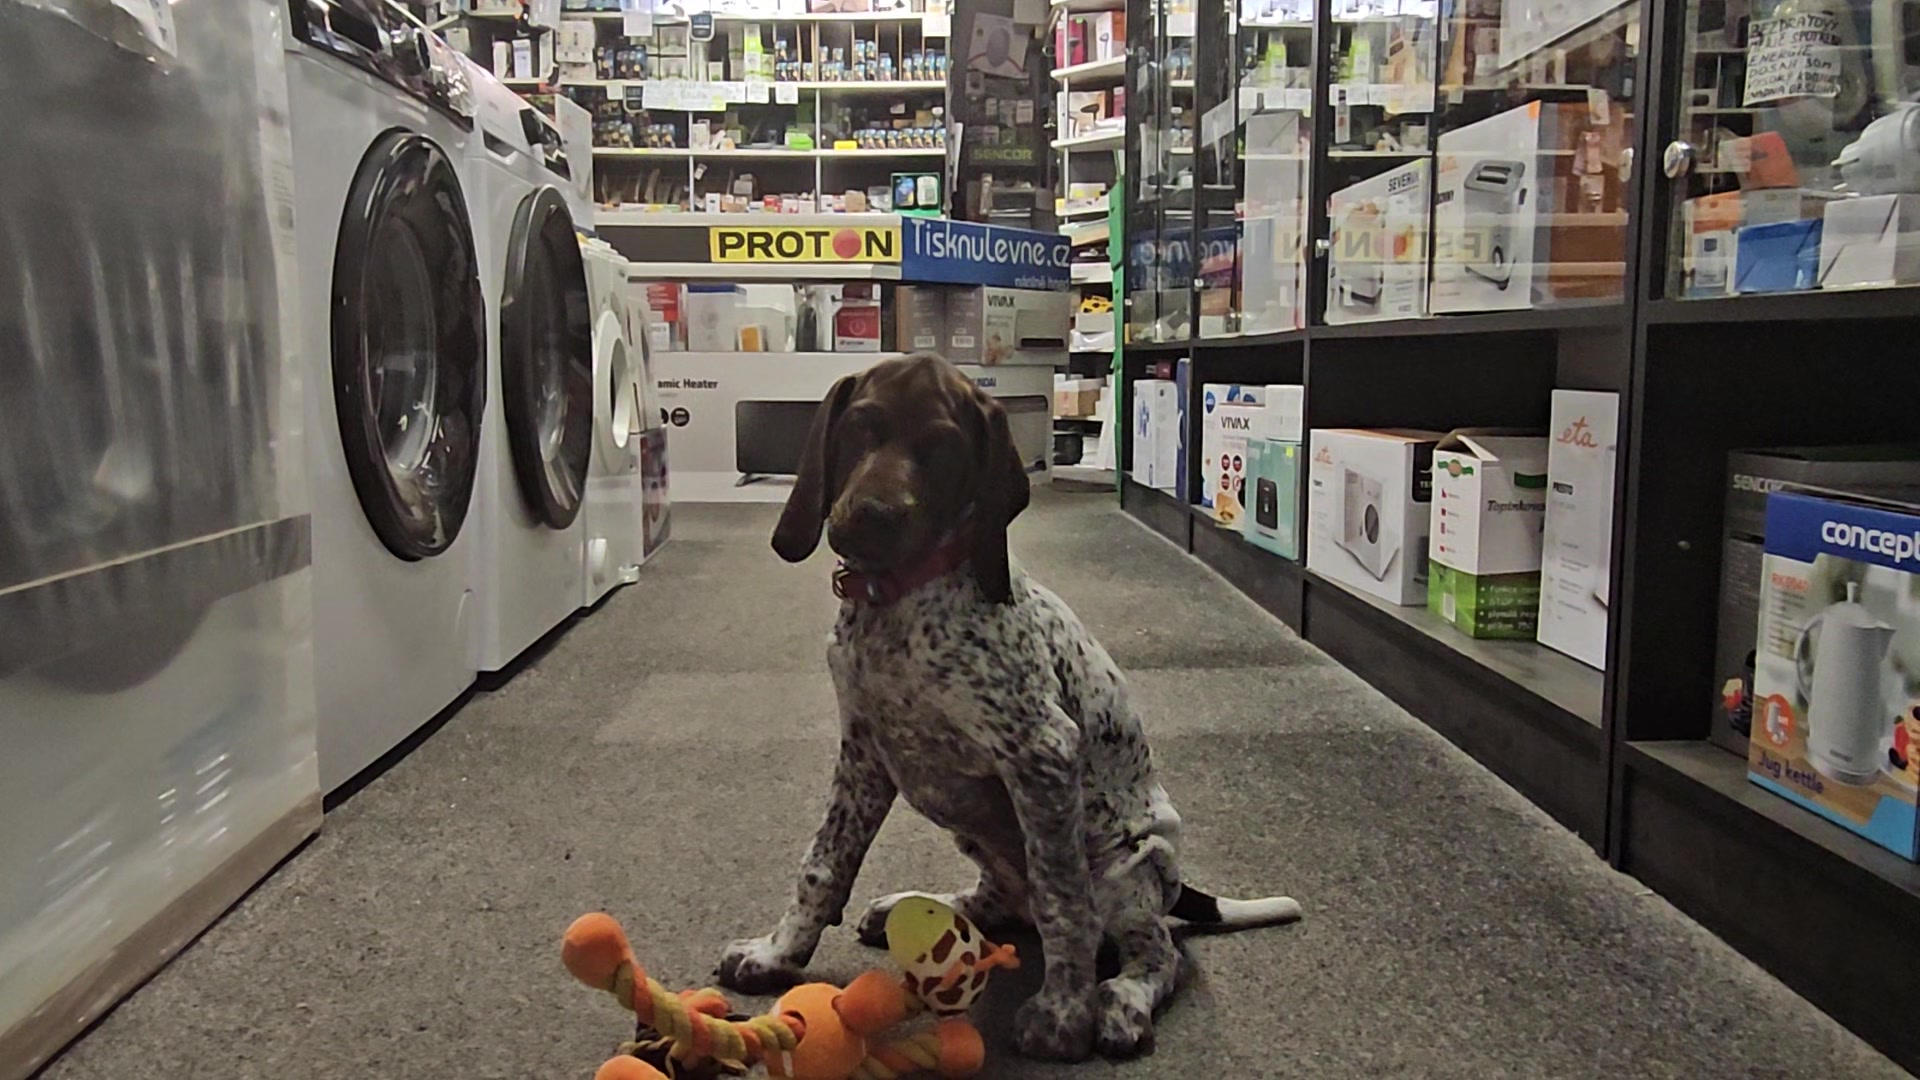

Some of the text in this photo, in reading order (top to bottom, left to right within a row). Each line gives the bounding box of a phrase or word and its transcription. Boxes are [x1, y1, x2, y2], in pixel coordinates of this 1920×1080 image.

[974, 148, 1033, 160] SENCOR
[718, 230, 892, 259] PROTON
[911, 219, 1070, 268] Tisknulevne.cz
[987, 295, 1015, 308] VIVAX
[683, 379, 719, 389] Heater
[1220, 416, 1251, 431] VIVAX
[1556, 416, 1598, 448] eta
[1758, 752, 1825, 794] Jug kettle
